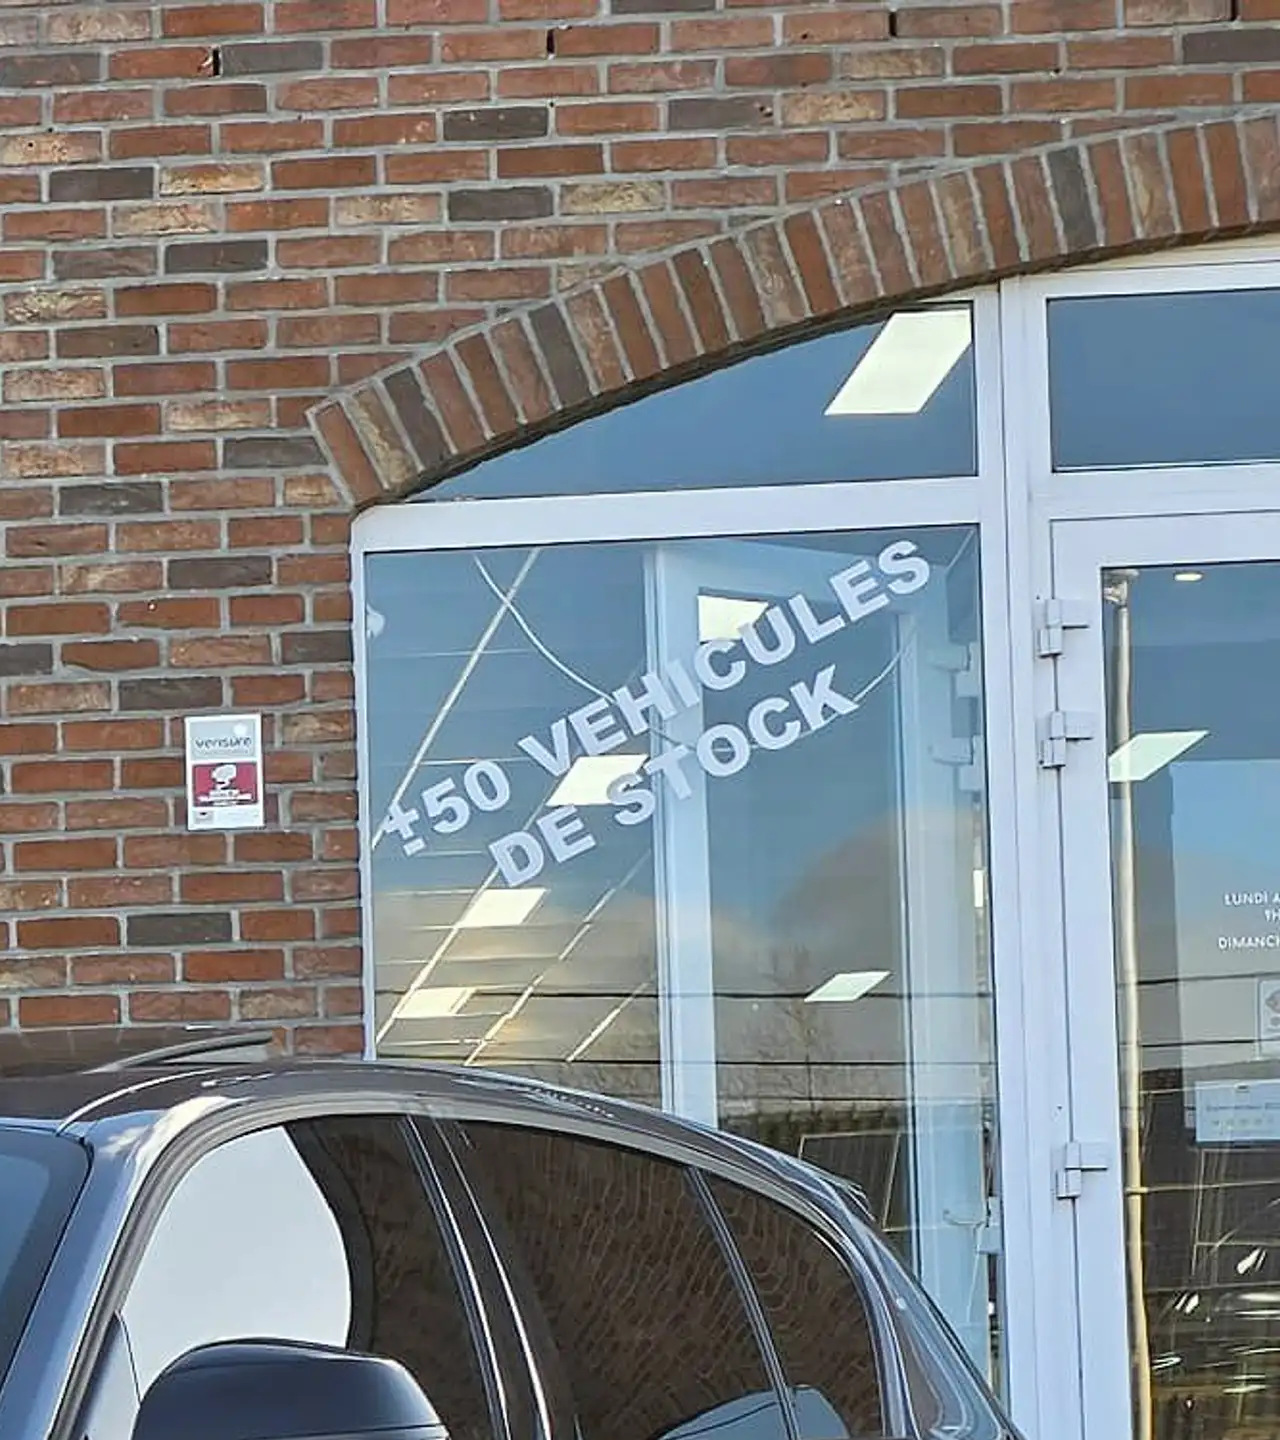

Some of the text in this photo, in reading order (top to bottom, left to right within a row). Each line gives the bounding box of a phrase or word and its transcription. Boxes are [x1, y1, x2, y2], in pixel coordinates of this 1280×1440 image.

[518, 540, 931, 778] VEHICULES
[488, 664, 860, 888] DE STOCK
